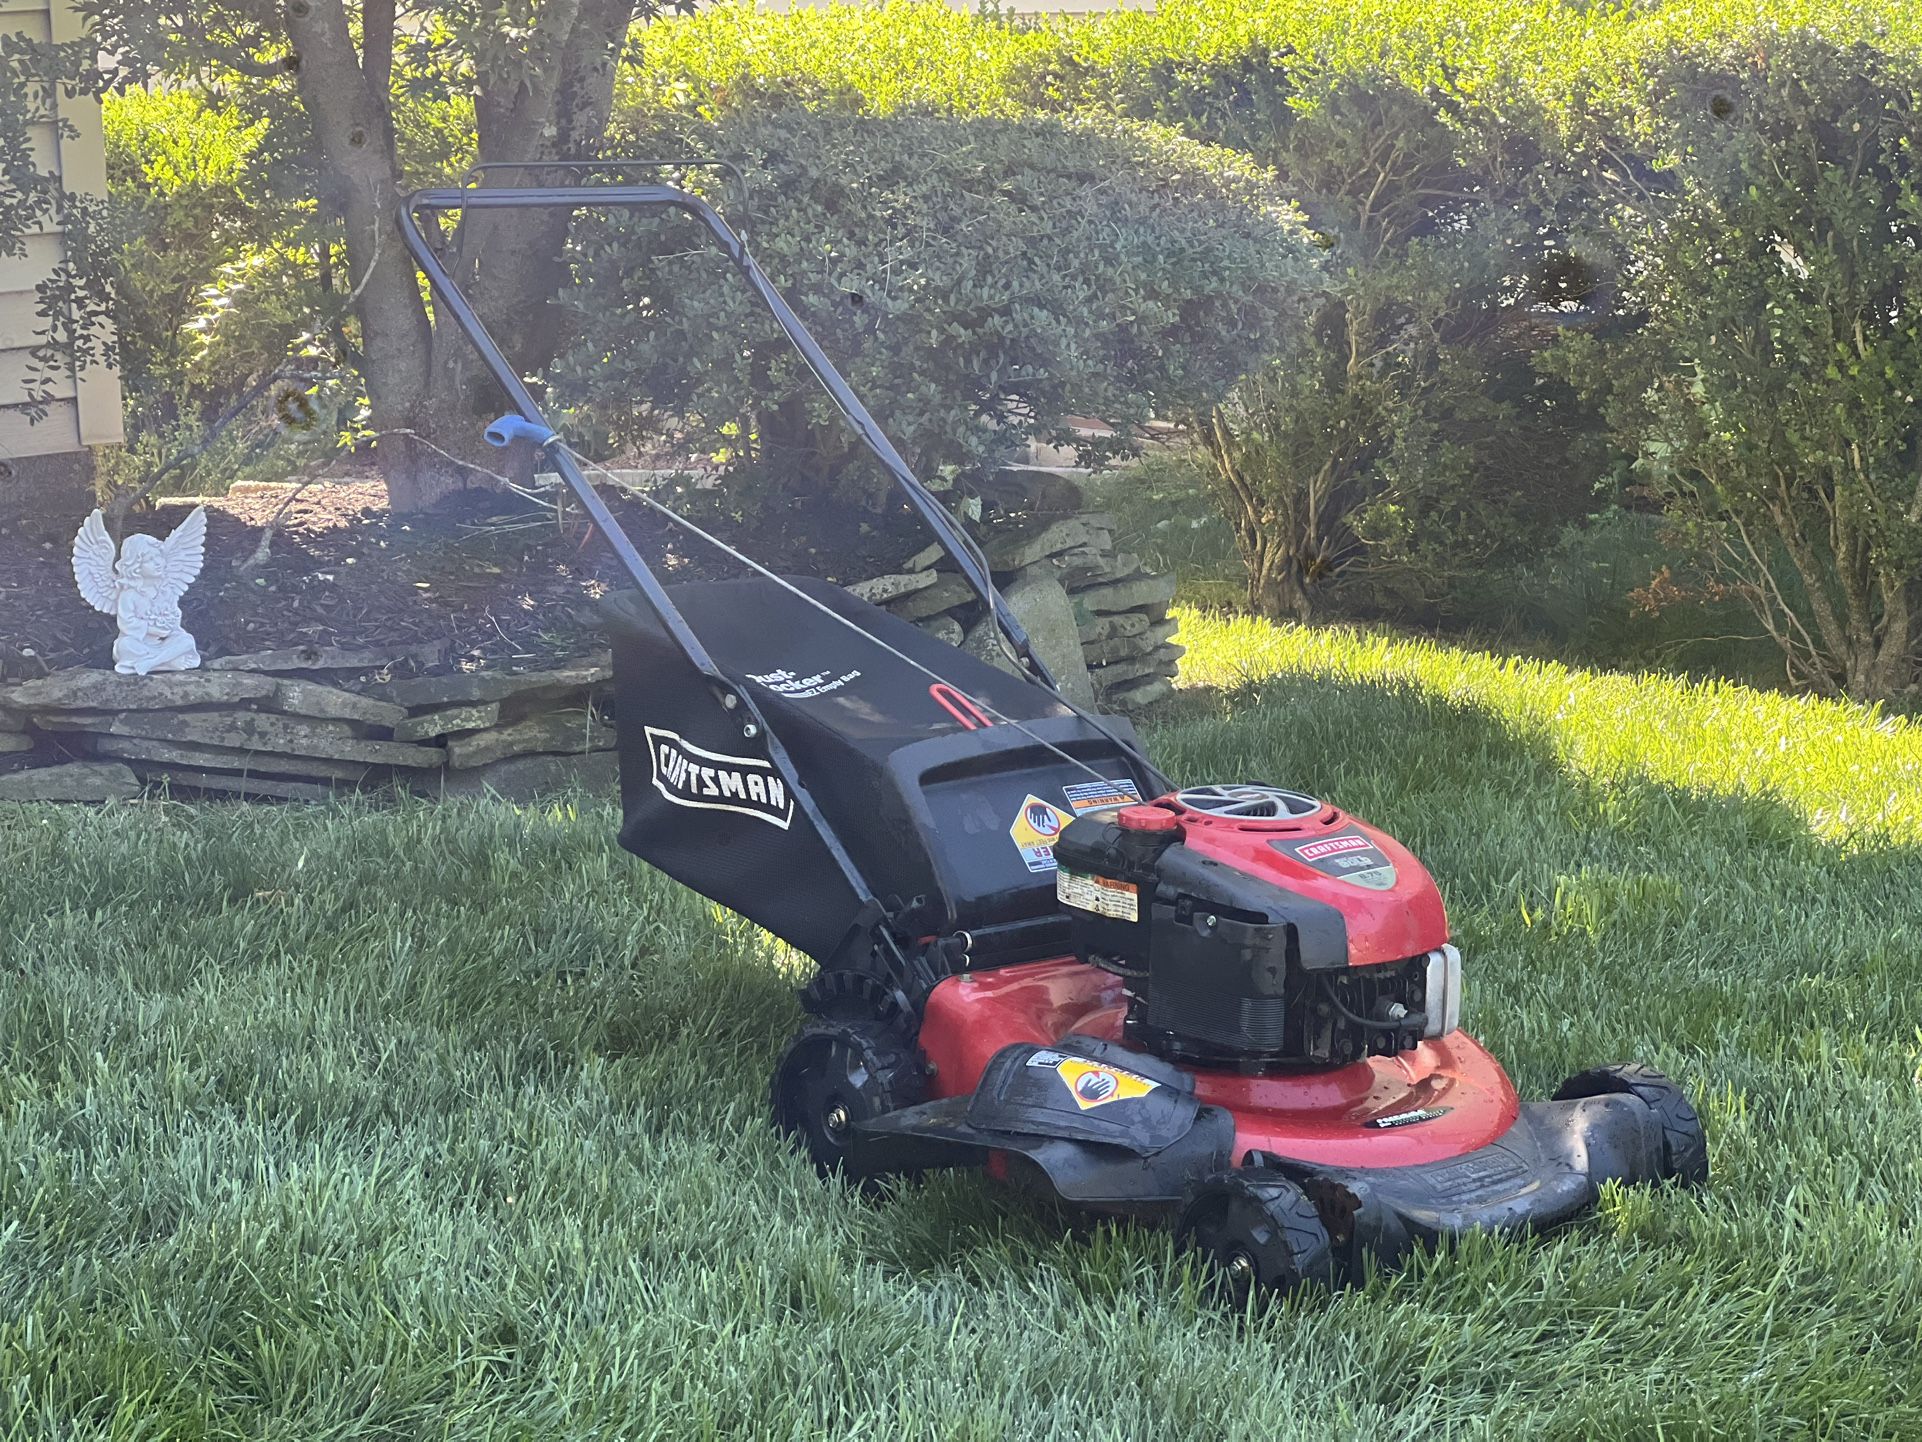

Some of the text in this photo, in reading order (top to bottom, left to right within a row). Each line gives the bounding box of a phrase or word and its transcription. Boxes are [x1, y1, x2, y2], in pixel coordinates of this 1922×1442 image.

[816, 679, 845, 693] Empty
[840, 669, 861, 682] Bag
[660, 743, 785, 810] CRAFTSMAN
[1087, 797, 1119, 806] WARNING
[1303, 838, 1366, 857] CRAFTSMAN
